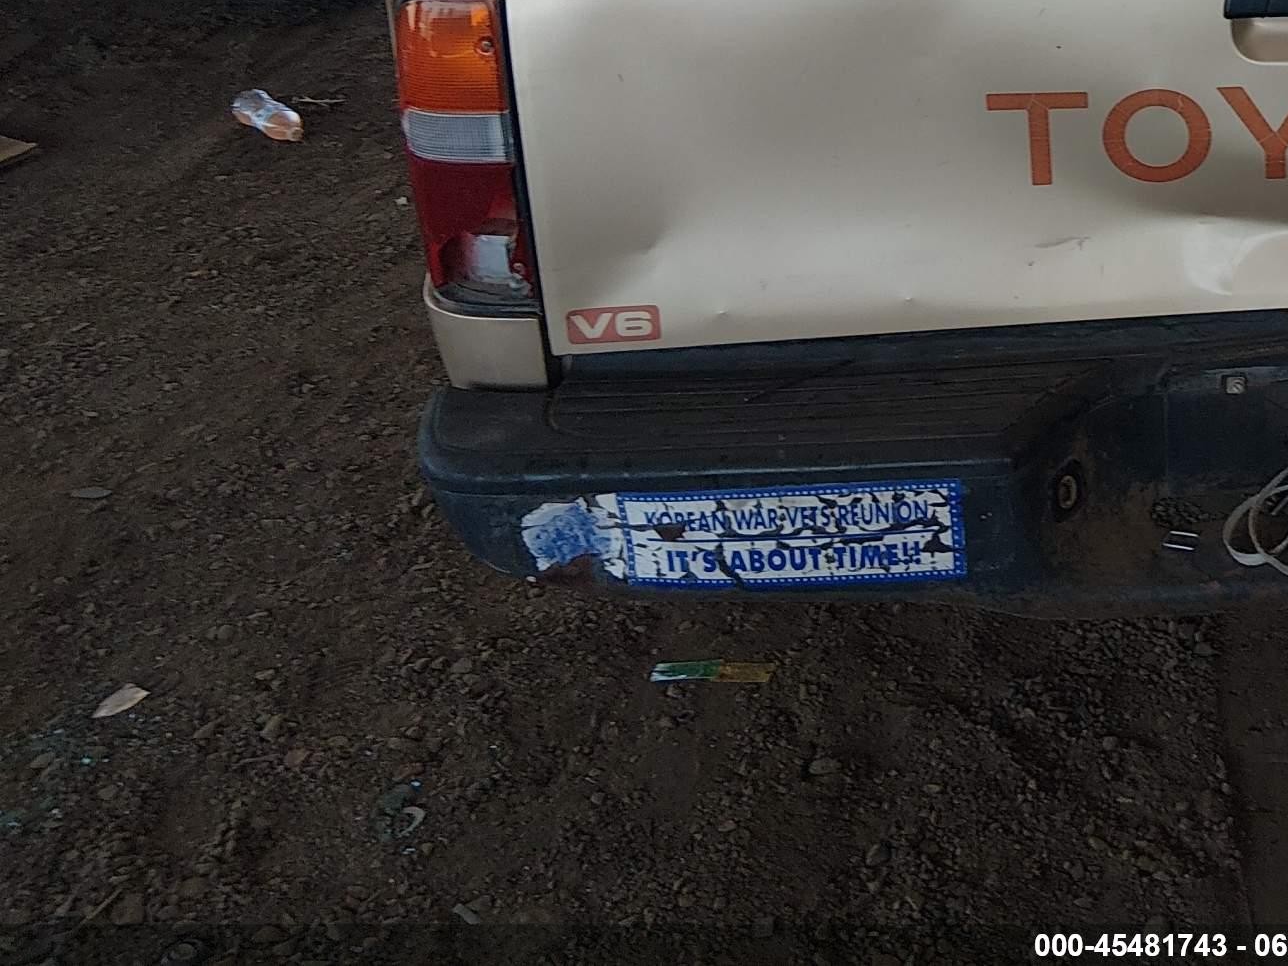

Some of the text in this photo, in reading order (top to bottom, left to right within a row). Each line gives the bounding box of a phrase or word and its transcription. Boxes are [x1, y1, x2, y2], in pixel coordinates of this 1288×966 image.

[568, 310, 654, 340] V6
[732, 507, 779, 531] WAR
[785, 505, 831, 528] VETS
[837, 499, 929, 526] REUNION
[666, 540, 921, 573] IT'S ABOUT TIME!!
